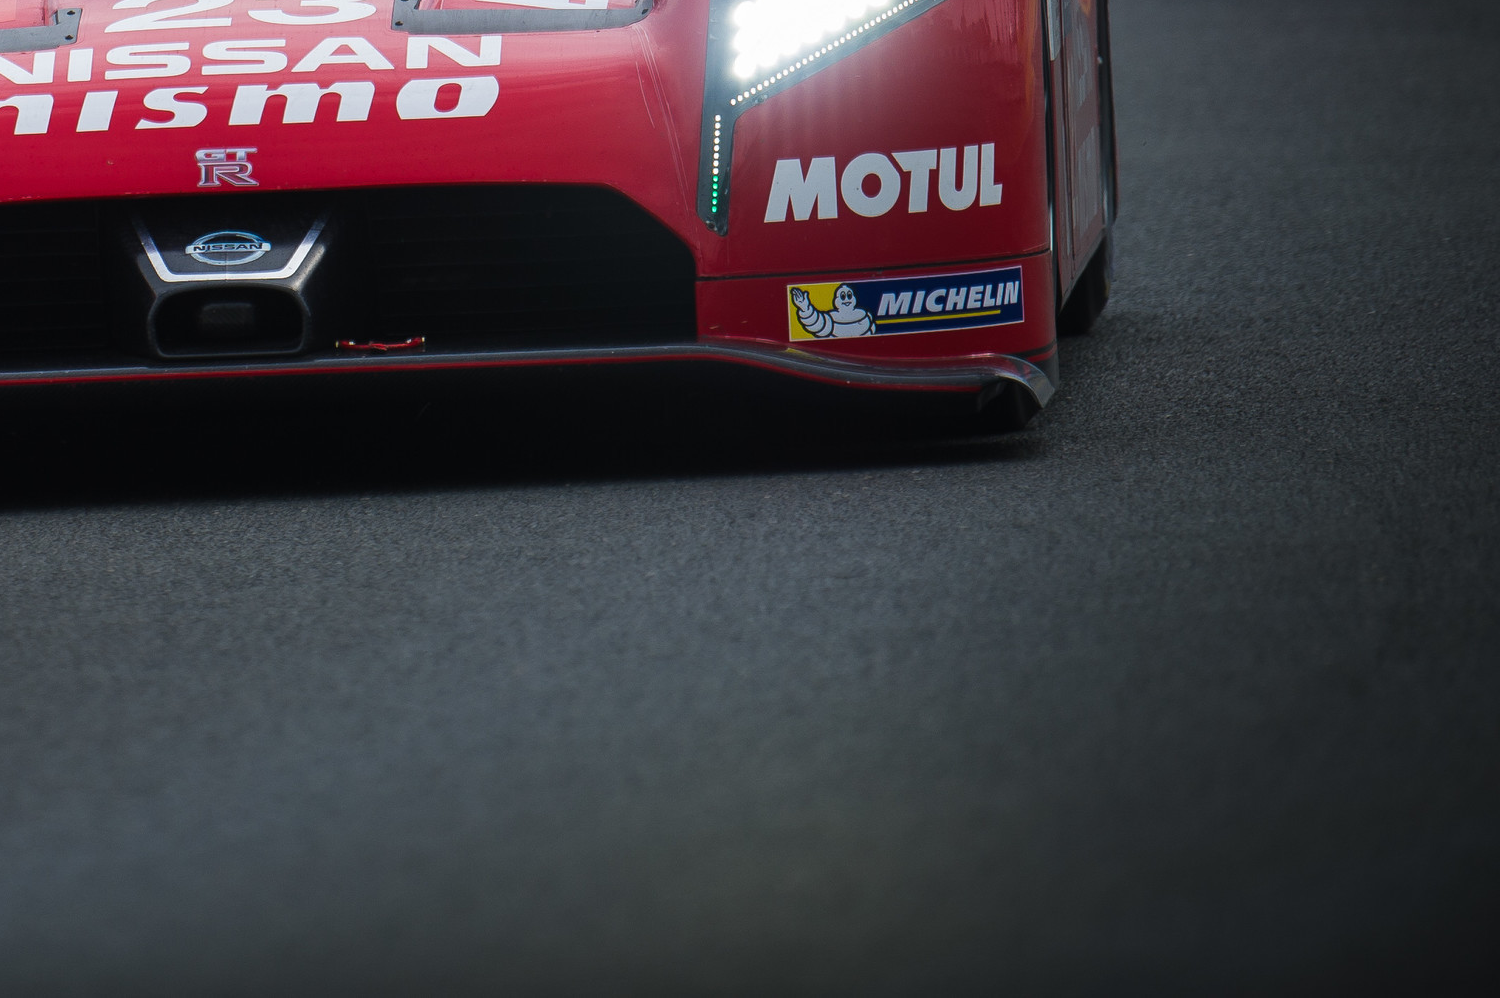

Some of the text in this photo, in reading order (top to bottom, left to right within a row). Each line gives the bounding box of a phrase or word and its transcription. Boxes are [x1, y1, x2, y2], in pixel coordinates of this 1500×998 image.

[763, 143, 1003, 223] MOTUL
[193, 242, 263, 252] NISSAN
[877, 279, 1020, 316] MICHELIN
